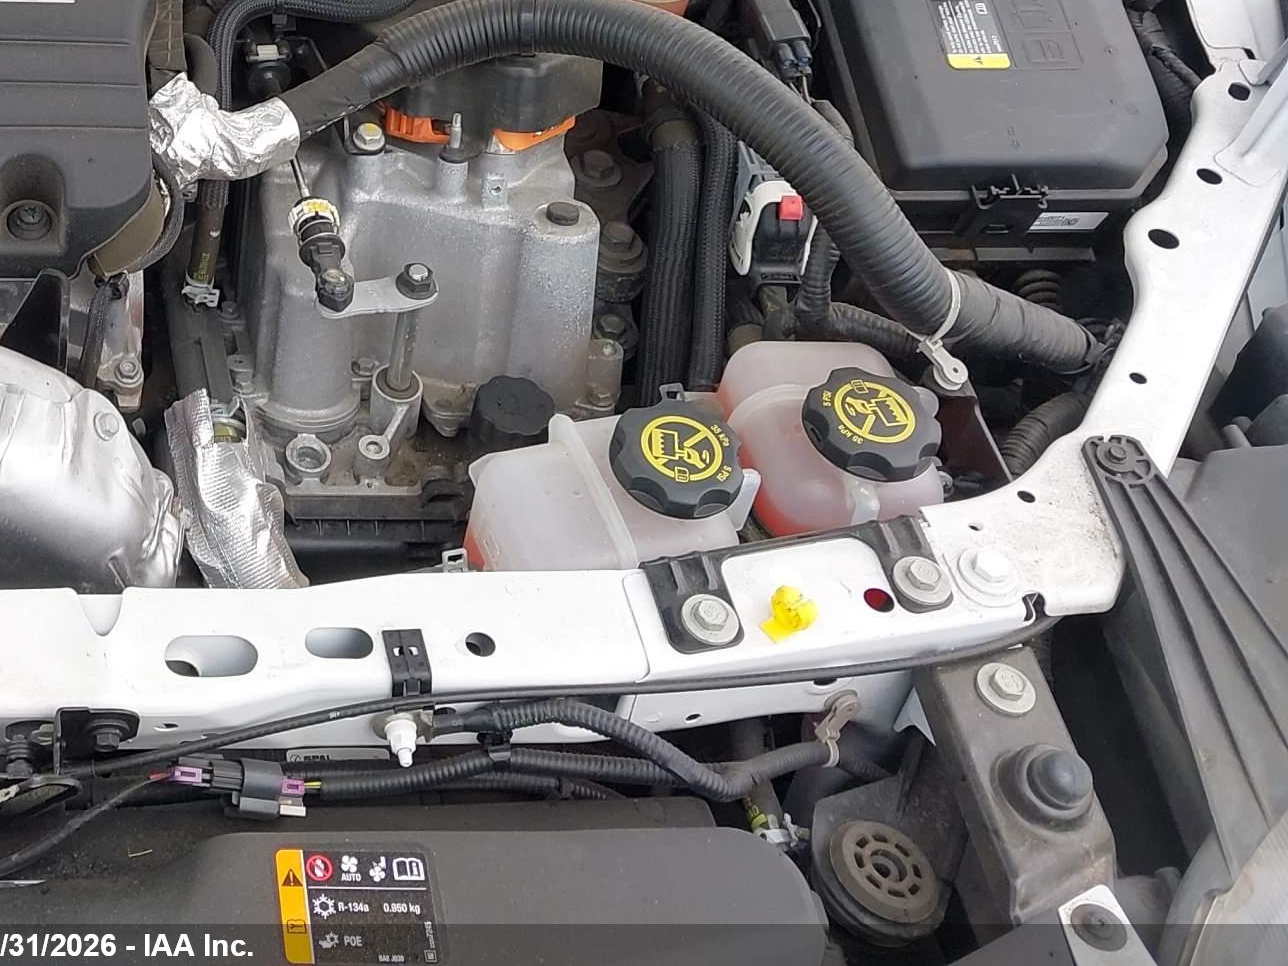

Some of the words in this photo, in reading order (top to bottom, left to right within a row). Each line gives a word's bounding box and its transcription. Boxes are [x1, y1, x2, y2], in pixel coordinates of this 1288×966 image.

[341, 873, 362, 882] AUTO
[338, 902, 370, 912] R-134a
[383, 902, 408, 913] 0.950
[409, 902, 421, 915] kg
[344, 935, 363, 947] POE
